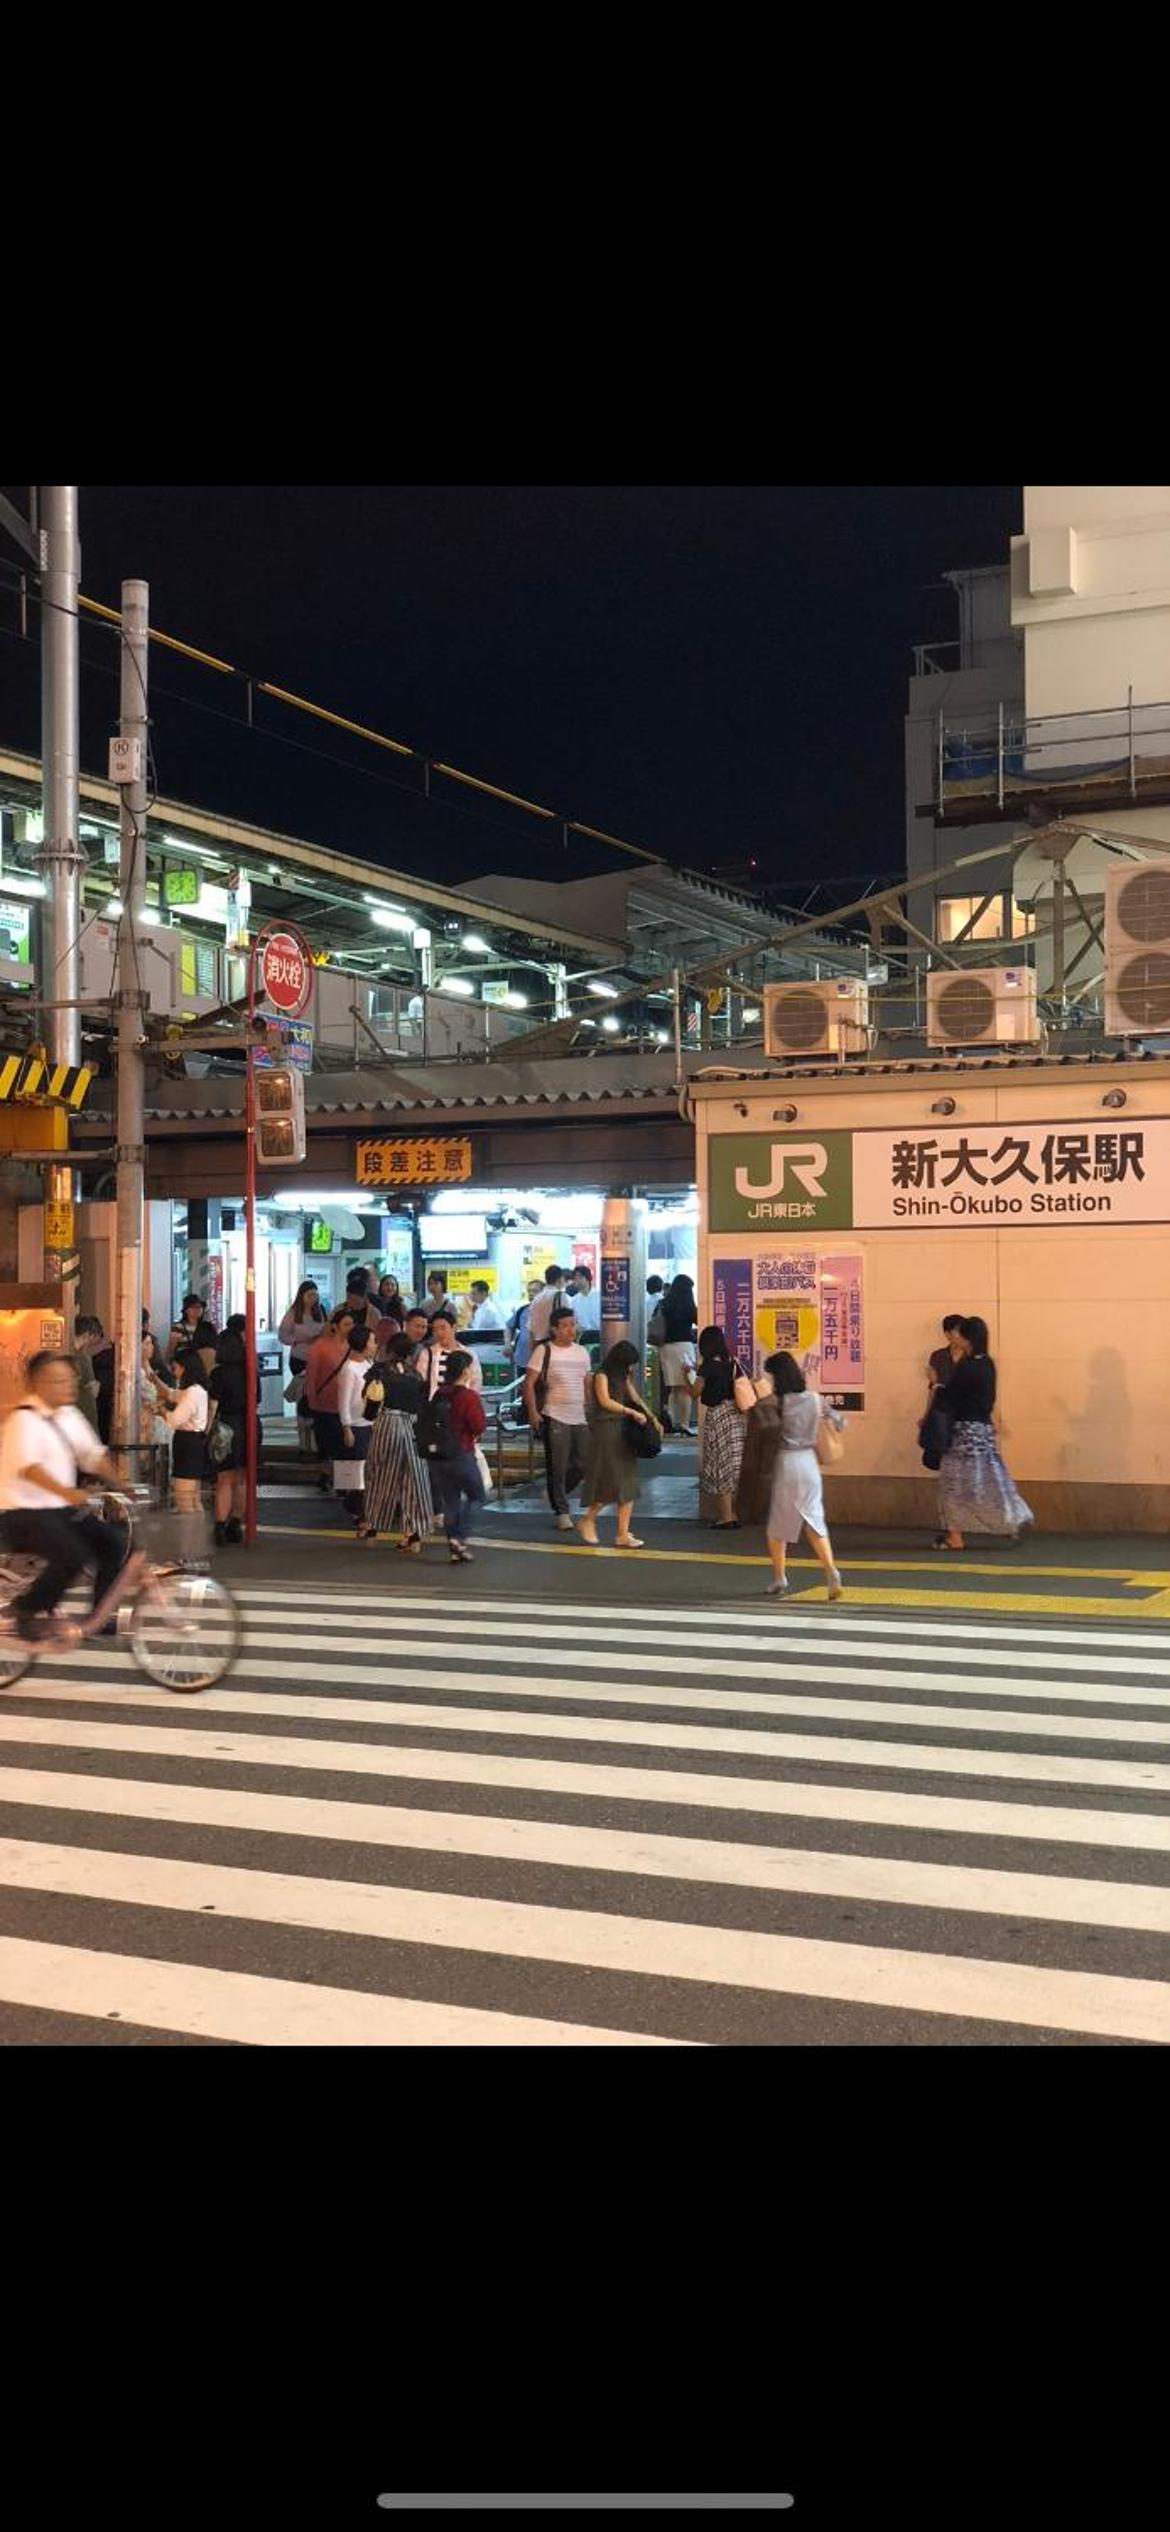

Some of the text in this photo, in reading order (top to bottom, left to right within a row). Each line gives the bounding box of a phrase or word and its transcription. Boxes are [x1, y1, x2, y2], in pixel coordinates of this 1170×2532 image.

[267, 953, 301, 988] 消火栓
[365, 1149, 464, 1174] 段差注意
[736, 1143, 828, 1199] JR
[892, 1133, 1145, 1189] 新大久保駅
[748, 1202, 817, 1218] JR東日本
[893, 1191, 1111, 1216] Shin-Ōkubo Station
[736, 1283, 751, 1361] 二万六千円
[823, 1287, 838, 1361] 一万五千円
